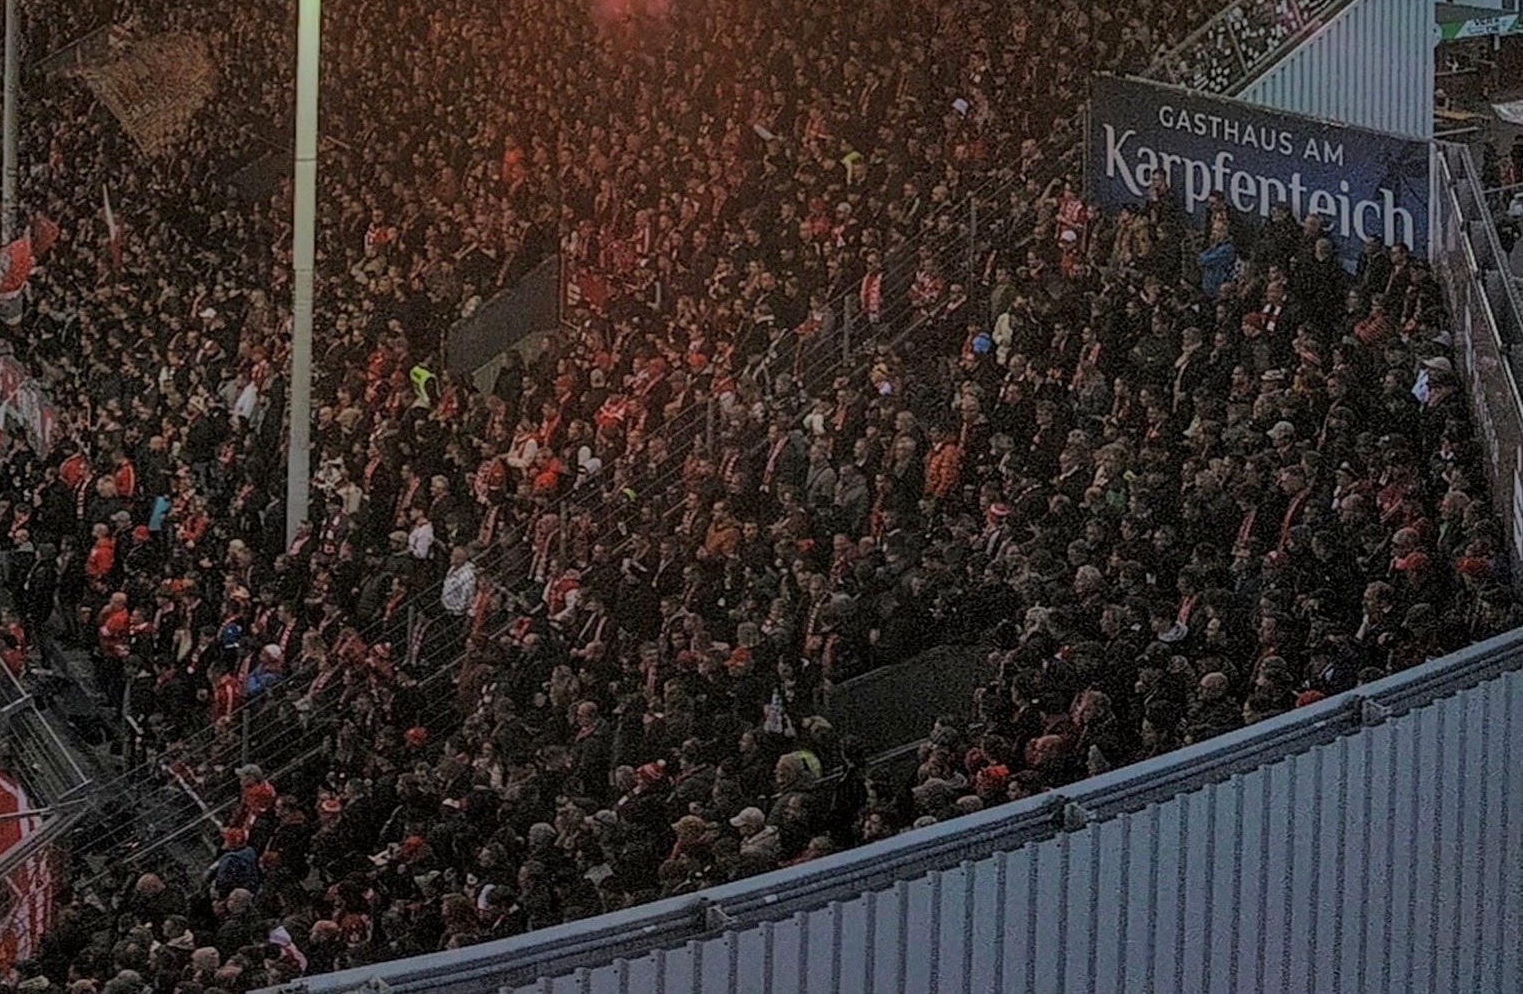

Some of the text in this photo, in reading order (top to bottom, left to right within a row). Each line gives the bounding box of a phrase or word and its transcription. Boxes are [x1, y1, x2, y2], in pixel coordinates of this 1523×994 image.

[1158, 105, 1345, 167] GASTHAUS AM
[1103, 123, 1415, 252] Karpfenteich
